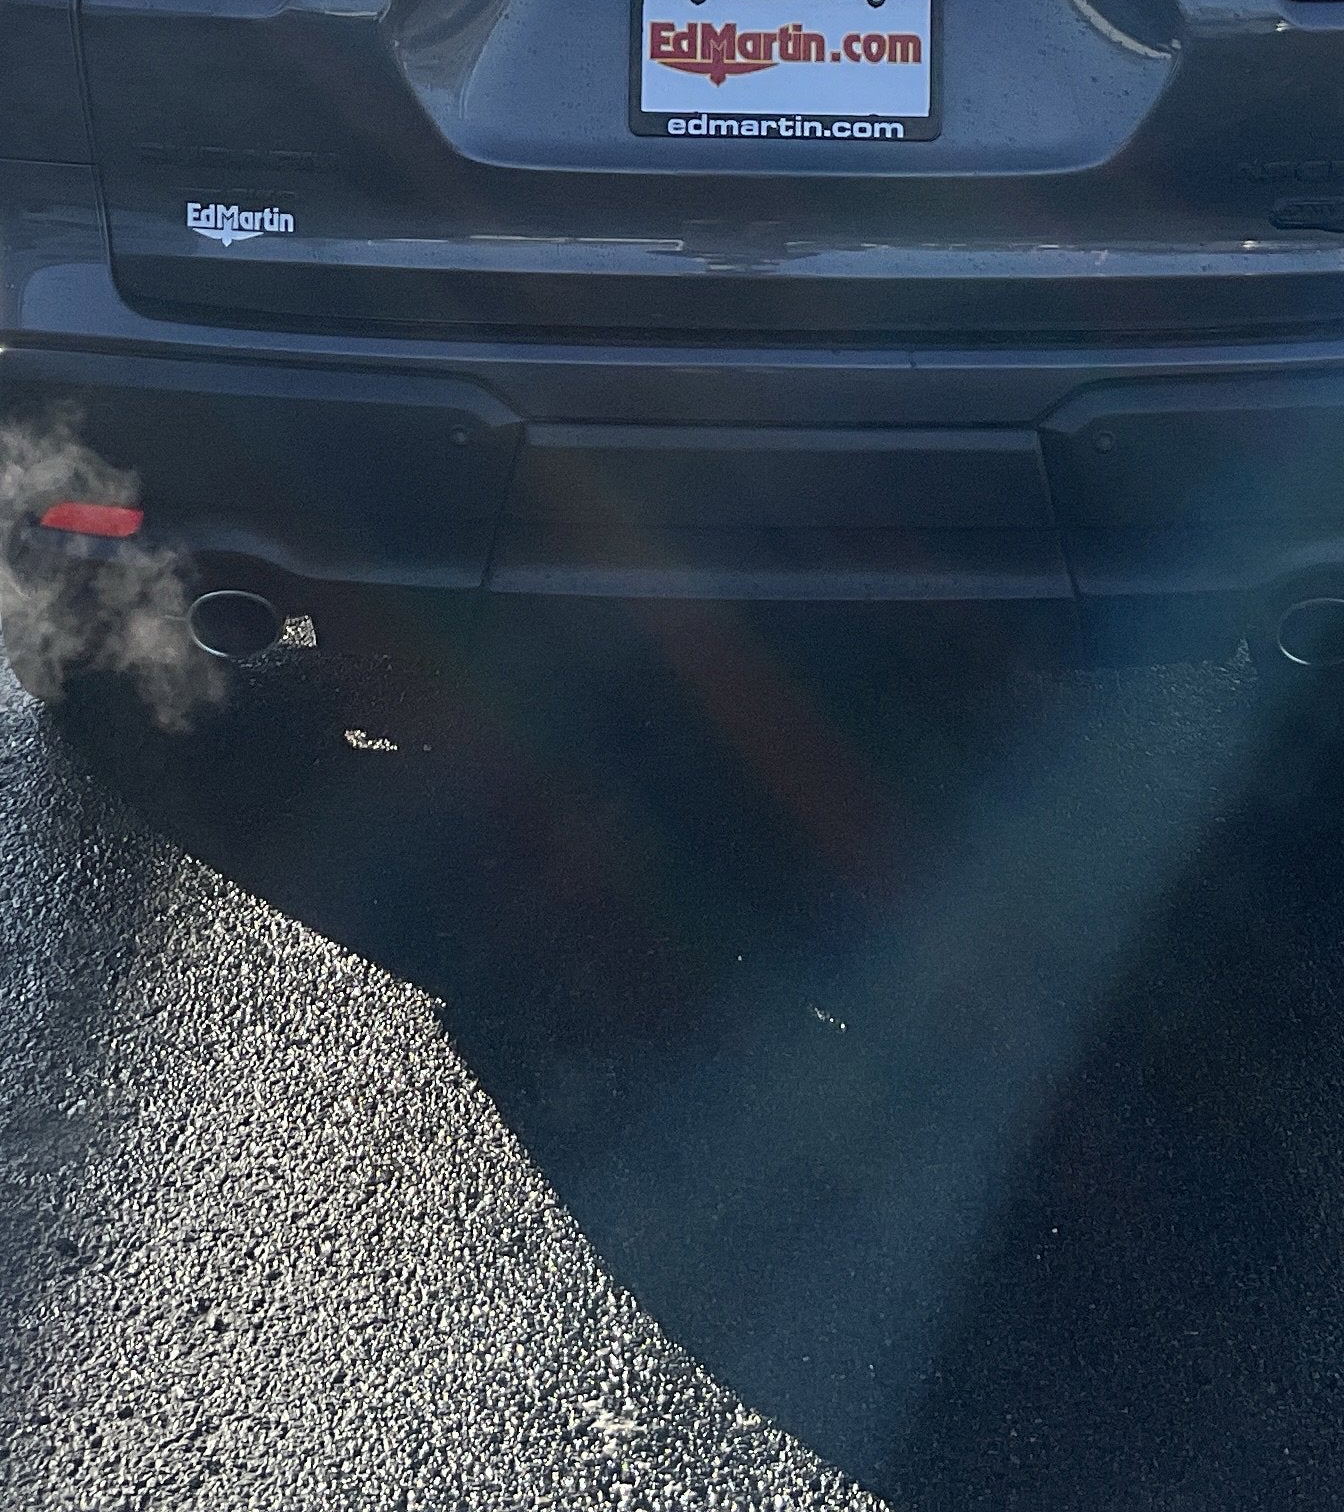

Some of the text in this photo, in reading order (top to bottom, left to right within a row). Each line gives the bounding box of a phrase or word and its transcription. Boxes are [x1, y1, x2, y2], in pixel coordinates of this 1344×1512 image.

[649, 21, 923, 65] EdMartin.com
[667, 114, 905, 139] edmartin.com
[187, 202, 294, 233] EdMartin
